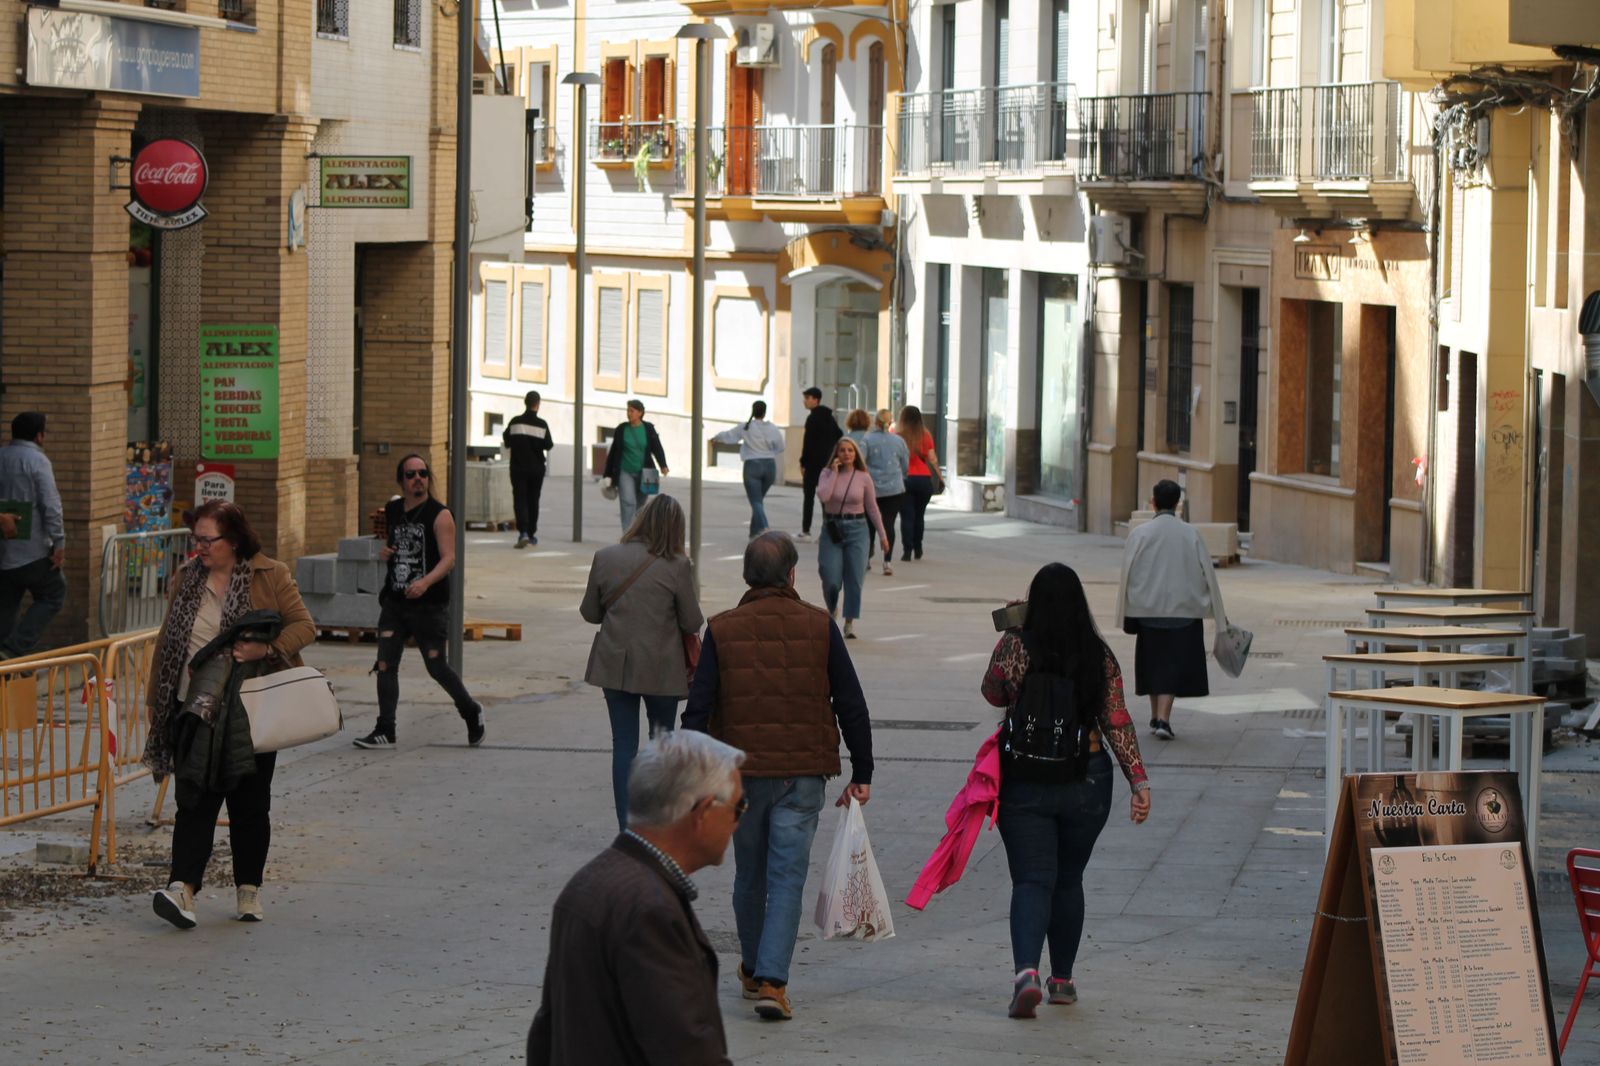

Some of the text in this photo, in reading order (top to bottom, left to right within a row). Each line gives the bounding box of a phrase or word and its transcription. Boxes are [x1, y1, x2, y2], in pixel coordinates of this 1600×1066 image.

[325, 160, 406, 168] ALIMENTACION
[135, 162, 200, 184] Coca-Cola
[325, 174, 408, 190] ALEX
[325, 196, 406, 204] ALIMENTACION
[205, 341, 273, 357] ALEX
[203, 361, 274, 369] ALIMENTACION
[213, 377, 236, 387] PAN
[213, 390, 262, 401] BEBIDAS
[214, 404, 262, 414] CHUCHES
[214, 417, 249, 428] FRUTA
[215, 430, 272, 441] VERDURAS
[214, 444, 254, 454] DULCES
[204, 481, 225, 489] Para
[201, 488, 228, 497] llevar
[1368, 798, 1466, 817] Nuestra Carta
